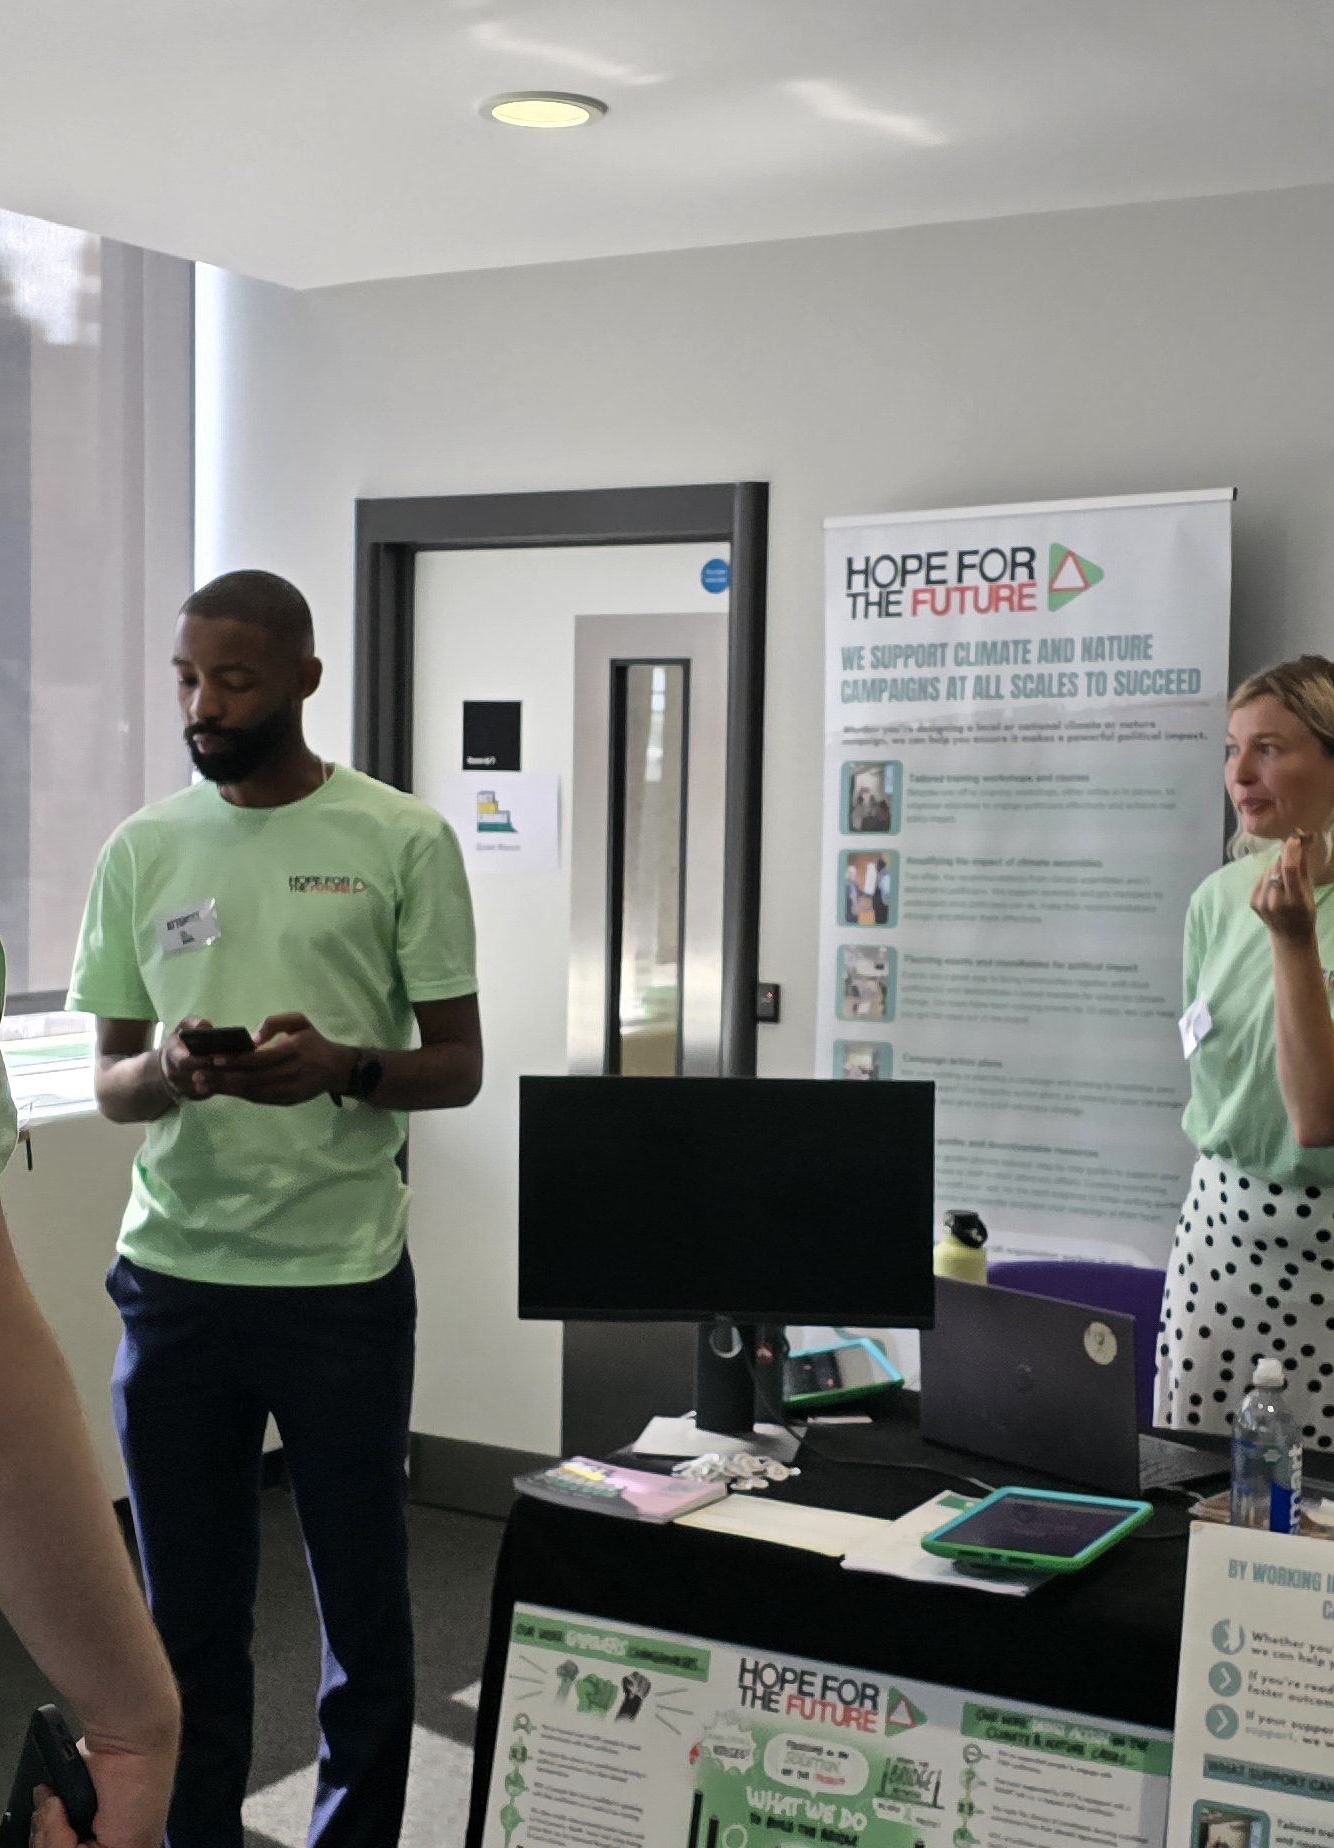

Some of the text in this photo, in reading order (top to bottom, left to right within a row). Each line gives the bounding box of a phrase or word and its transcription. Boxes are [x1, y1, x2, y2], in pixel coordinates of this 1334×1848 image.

[846, 546, 1037, 590] HOPE FOR
[847, 582, 1037, 620] THE FUTURE
[841, 634, 1153, 671] WE SUPPORT CLIMATE AND NATURE
[841, 668, 1201, 703] CAMPAIGNS AT ALL SCALES TO SUCCEED
[1228, 1559, 1248, 1580] BY
[1253, 1562, 1321, 1592] WORKING
[1252, 1630, 1304, 1648] Whether
[1251, 1648, 1268, 1656] we
[1298, 1650, 1325, 1667] help
[740, 1658, 880, 1711] HOPE FOR
[1261, 1676, 1301, 1689] you're
[739, 1685, 879, 1734] THE FUTURE
[1258, 1715, 1286, 1726] your
[746, 1786, 805, 1818] WHAT
[805, 1799, 838, 1824] WE
[838, 1807, 867, 1831] DO
